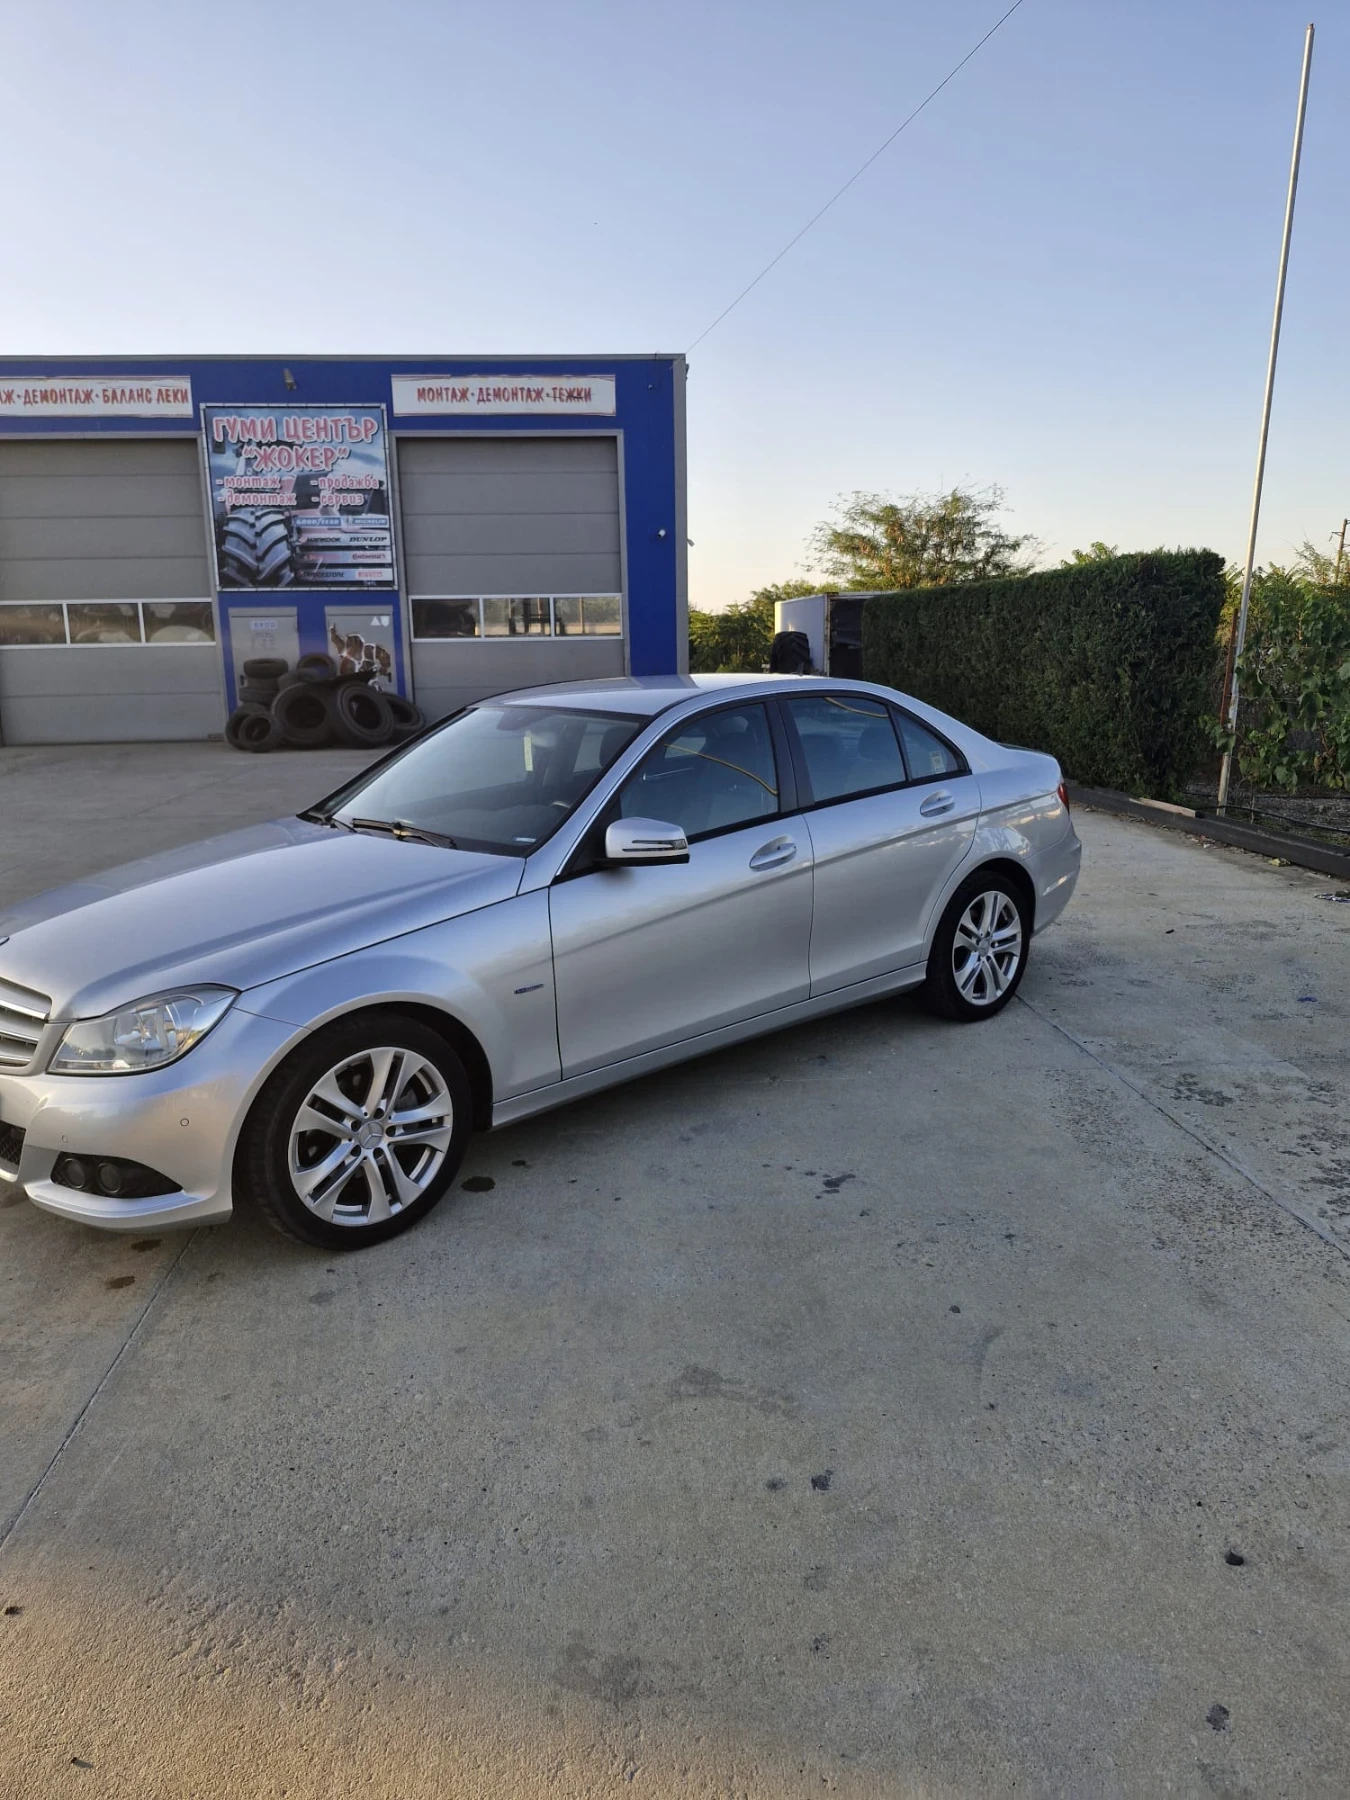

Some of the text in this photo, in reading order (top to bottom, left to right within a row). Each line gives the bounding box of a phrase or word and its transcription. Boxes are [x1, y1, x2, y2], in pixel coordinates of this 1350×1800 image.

[23, 388, 94, 406] ДЕМОНТАЖ
[102, 387, 151, 404] БАЛАНС
[156, 388, 189, 404] ЛЕКИ
[417, 387, 469, 402] МОНТАЖ
[477, 386, 545, 404] ДЕМОНТАЖ
[213, 416, 378, 442] ГУМИ ЦЕНТЪР
